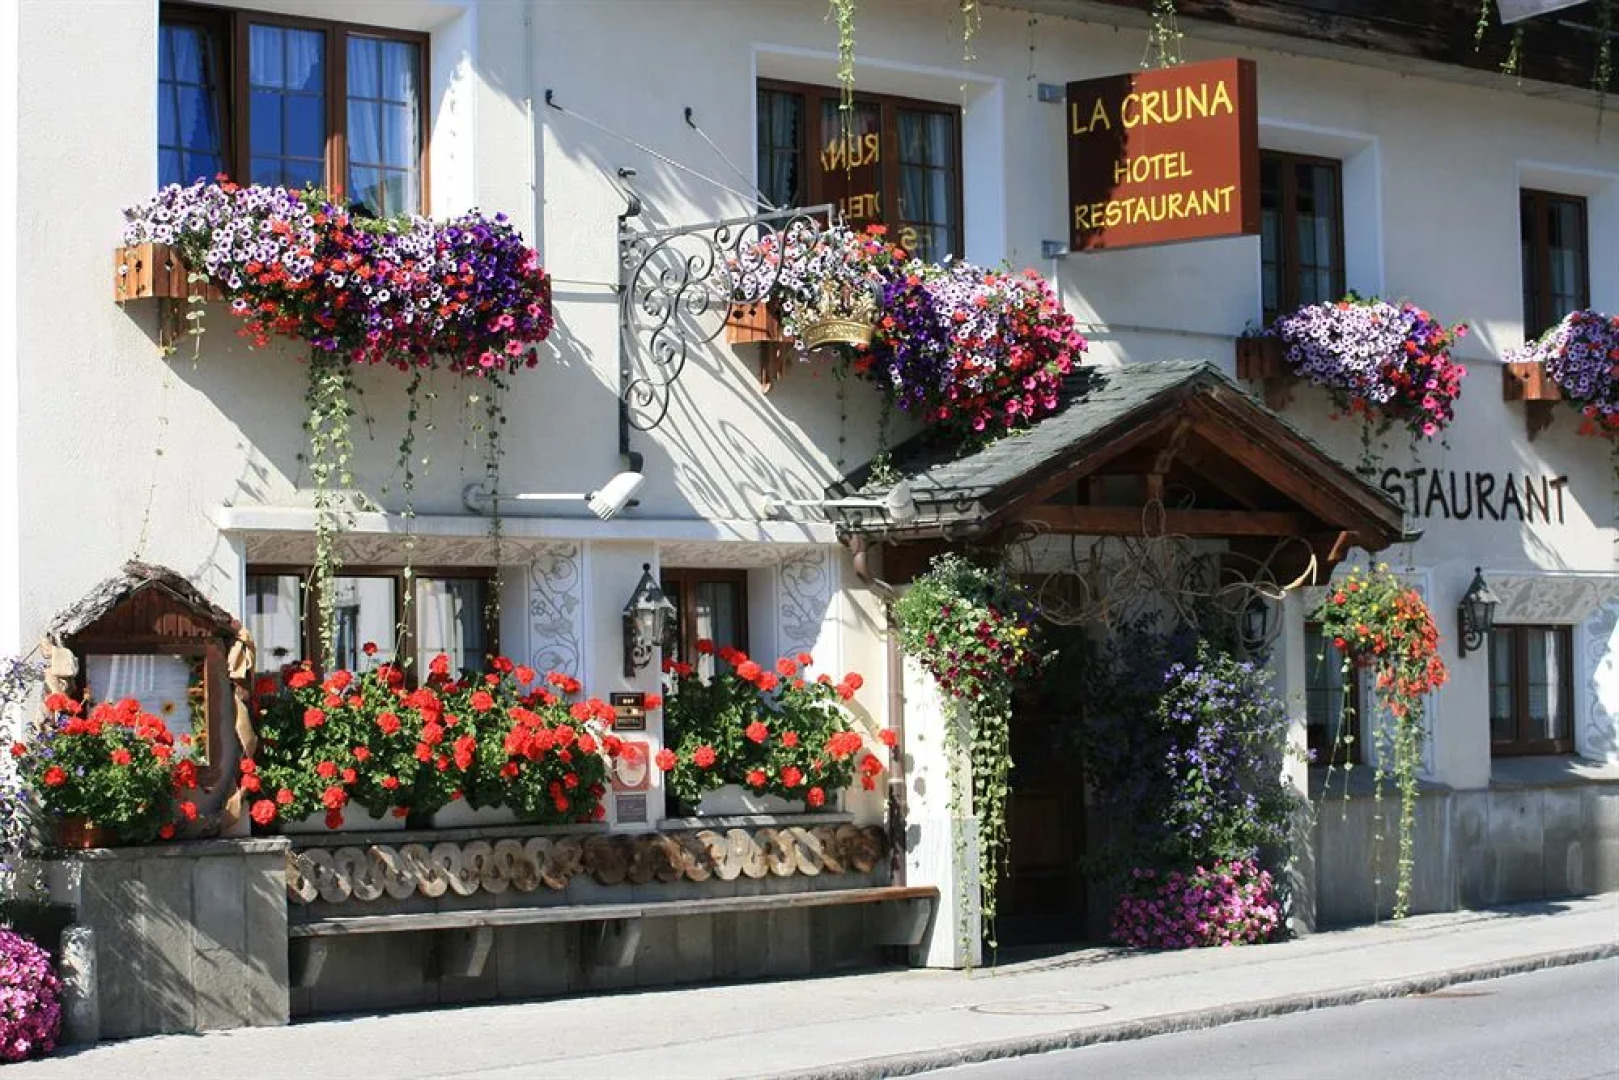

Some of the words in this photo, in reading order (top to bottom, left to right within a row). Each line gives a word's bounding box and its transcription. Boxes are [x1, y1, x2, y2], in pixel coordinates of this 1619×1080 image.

[1072, 99, 1111, 135] LA
[1121, 80, 1234, 130] CRUNA
[1114, 151, 1193, 184] HOTEL
[1075, 185, 1236, 230] RESTAURANT
[1355, 466, 1568, 525] STAURANT
